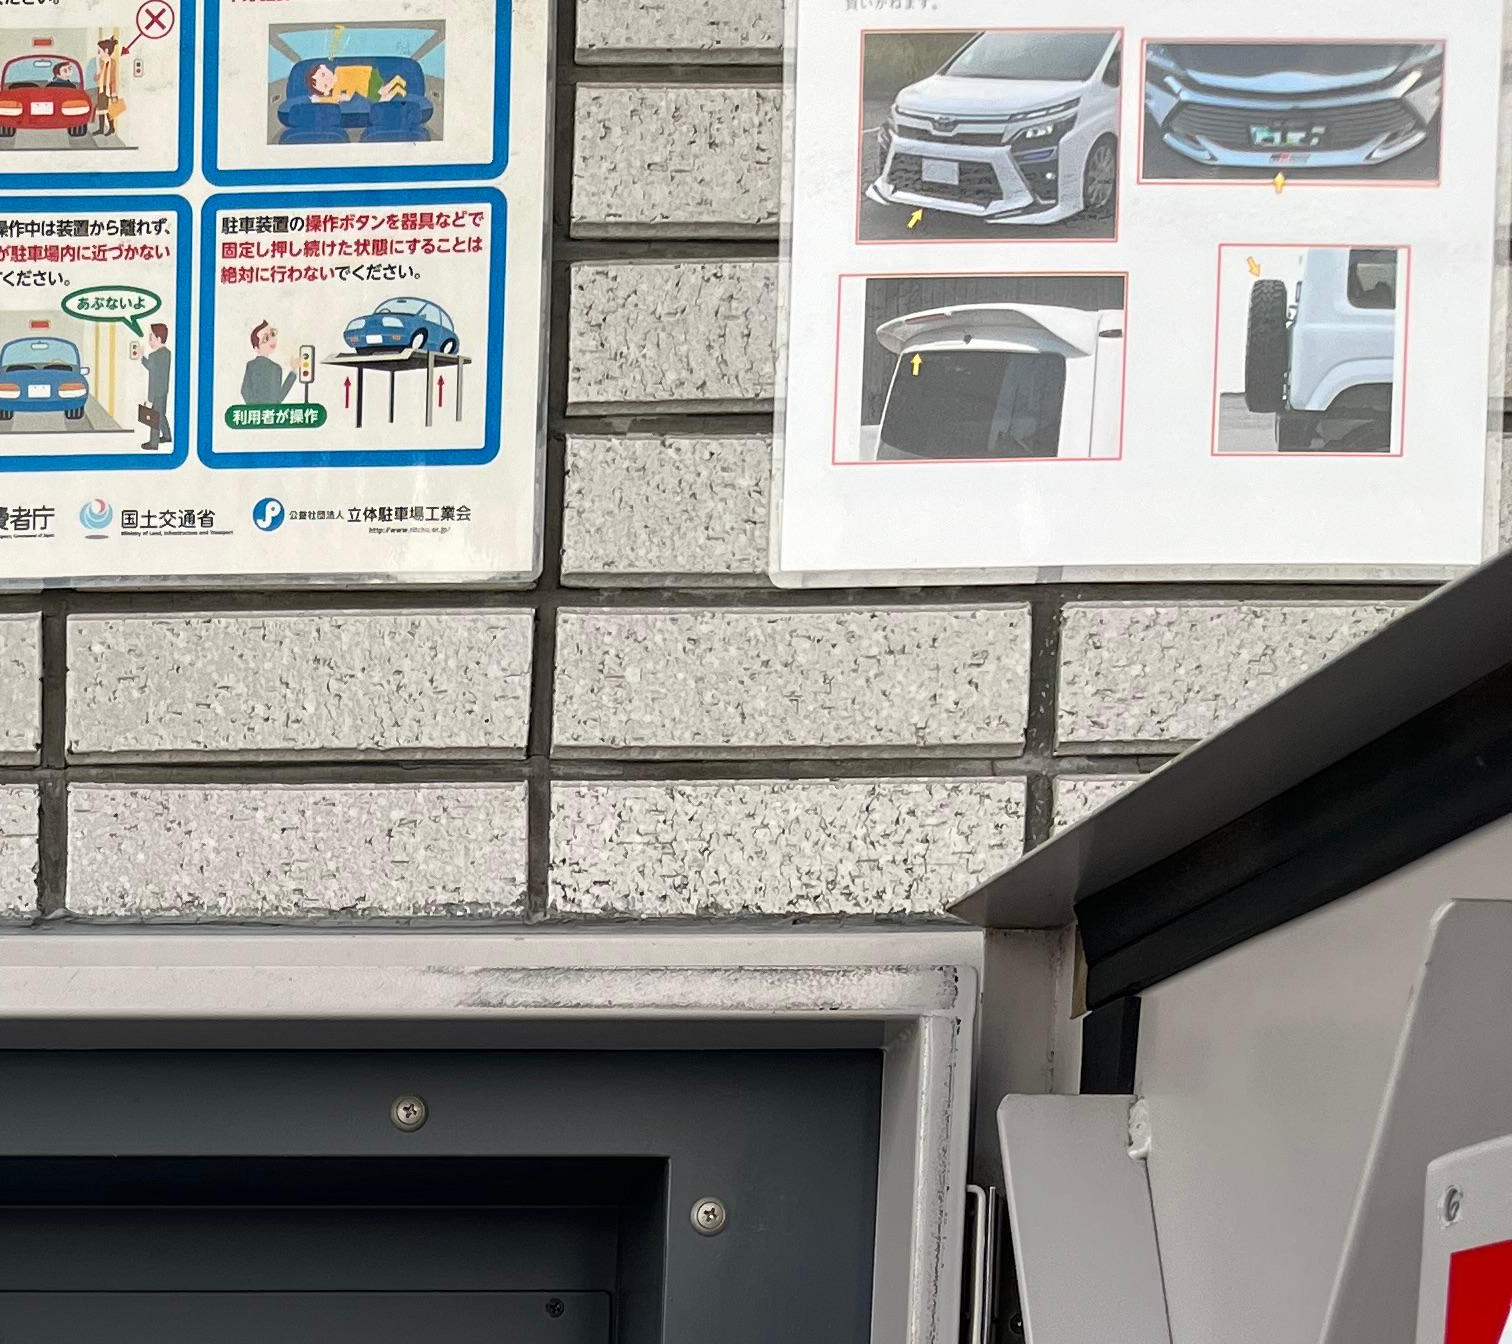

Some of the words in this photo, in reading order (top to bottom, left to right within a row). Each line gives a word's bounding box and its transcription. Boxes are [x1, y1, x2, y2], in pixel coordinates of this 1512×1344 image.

[221, 211, 484, 236] 駐車装置の操作ボタンを器具などで
[221, 236, 483, 260] 固定し押し続けた状態にすることは
[221, 262, 421, 285] 絶対に行わないでください。
[76, 293, 146, 312] あぶないよ
[232, 408, 319, 428] 利用者が操作
[121, 509, 216, 529] 国土交通省
[347, 506, 472, 523] 立体駐車場工業会
